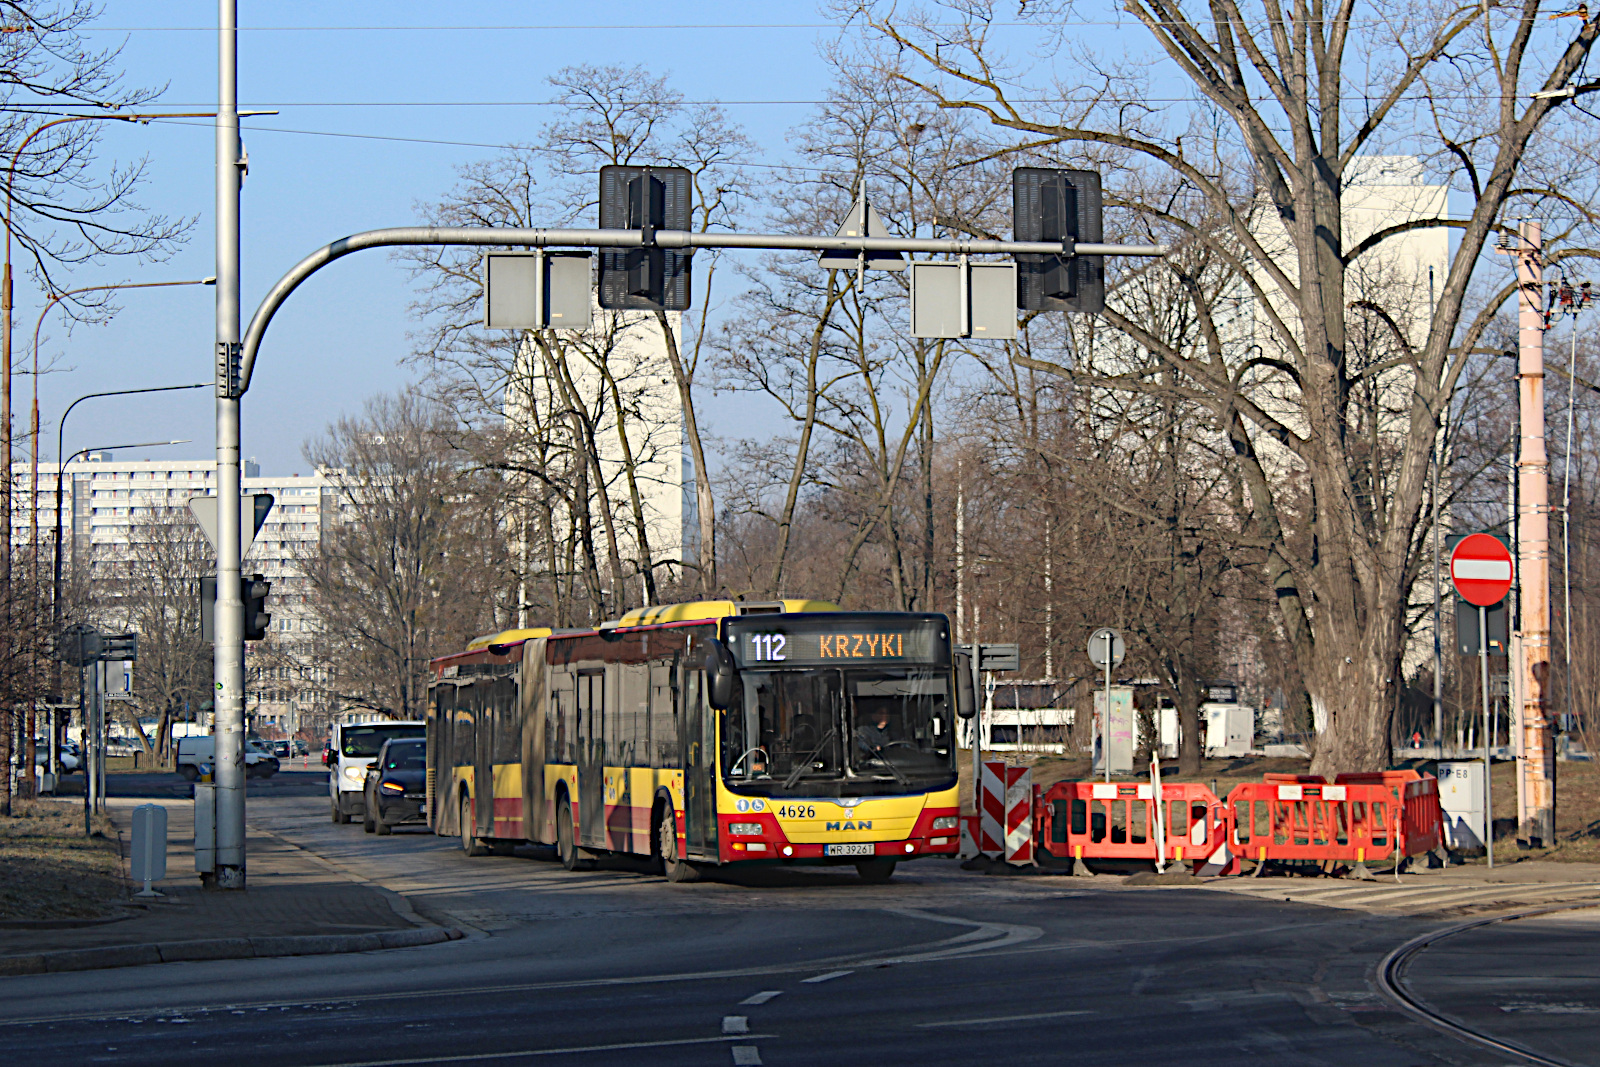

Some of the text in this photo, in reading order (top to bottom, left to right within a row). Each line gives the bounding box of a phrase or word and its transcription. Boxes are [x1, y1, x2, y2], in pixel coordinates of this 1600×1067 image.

[752, 633, 903, 661] 112 KRZYKI
[779, 805, 816, 818] 4626
[826, 821, 872, 831] MAN
[830, 845, 873, 855] WR 3926T
